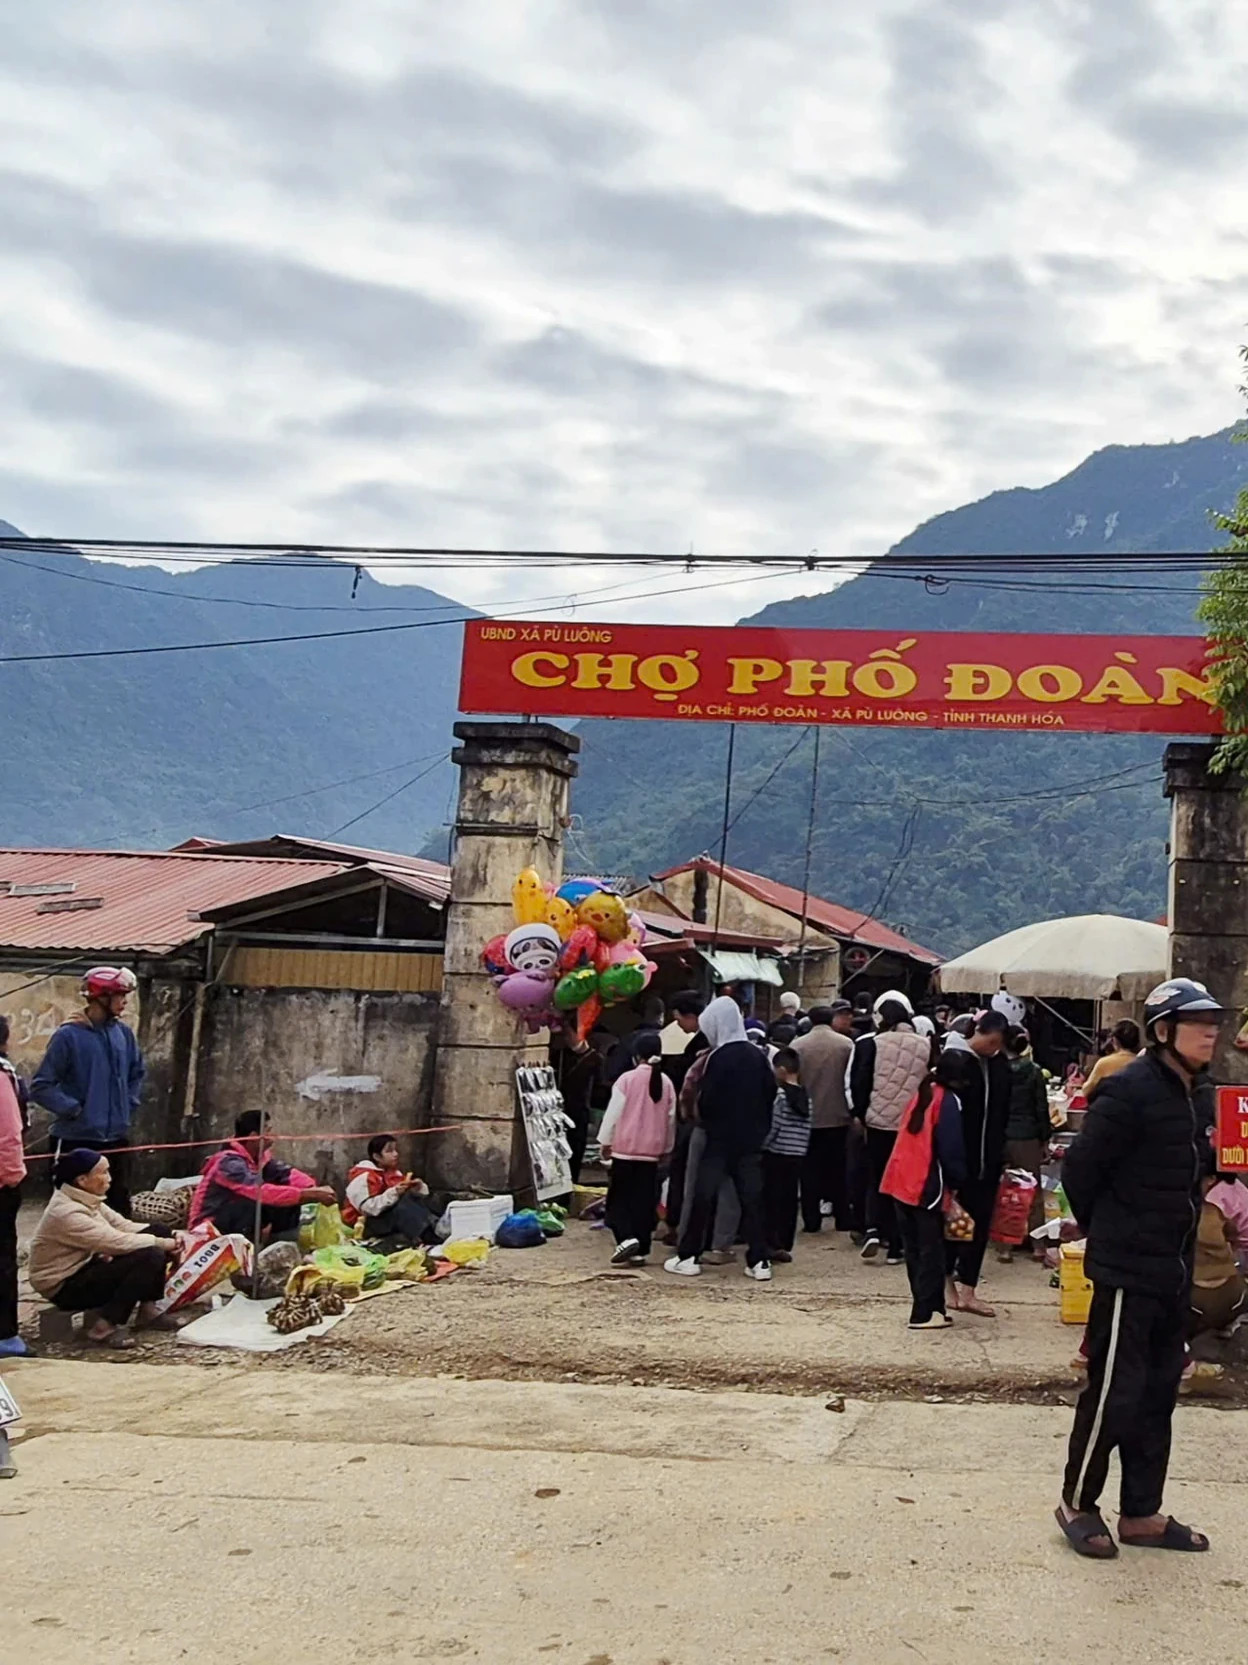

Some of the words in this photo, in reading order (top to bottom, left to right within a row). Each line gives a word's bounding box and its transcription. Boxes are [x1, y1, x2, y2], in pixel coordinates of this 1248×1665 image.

[480, 627, 516, 640] UBND
[520, 625, 540, 641] XÃ
[543, 626, 561, 641] PÙ
[564, 627, 612, 643] LUÔNG
[511, 650, 700, 701] CHỢ
[726, 638, 917, 698] PHỐ
[944, 651, 1220, 706] ĐOÀN
[677, 704, 702, 718] ĐỊA
[738, 702, 769, 717] PHỐ
[773, 704, 817, 718] ĐOÀN
[832, 706, 851, 719] XÃ
[856, 706, 873, 719] PÙ
[877, 708, 928, 721] LUÔNG
[943, 708, 975, 723] TỈNH
[979, 712, 1027, 723] THANH
[1032, 710, 1064, 725] HÓA
